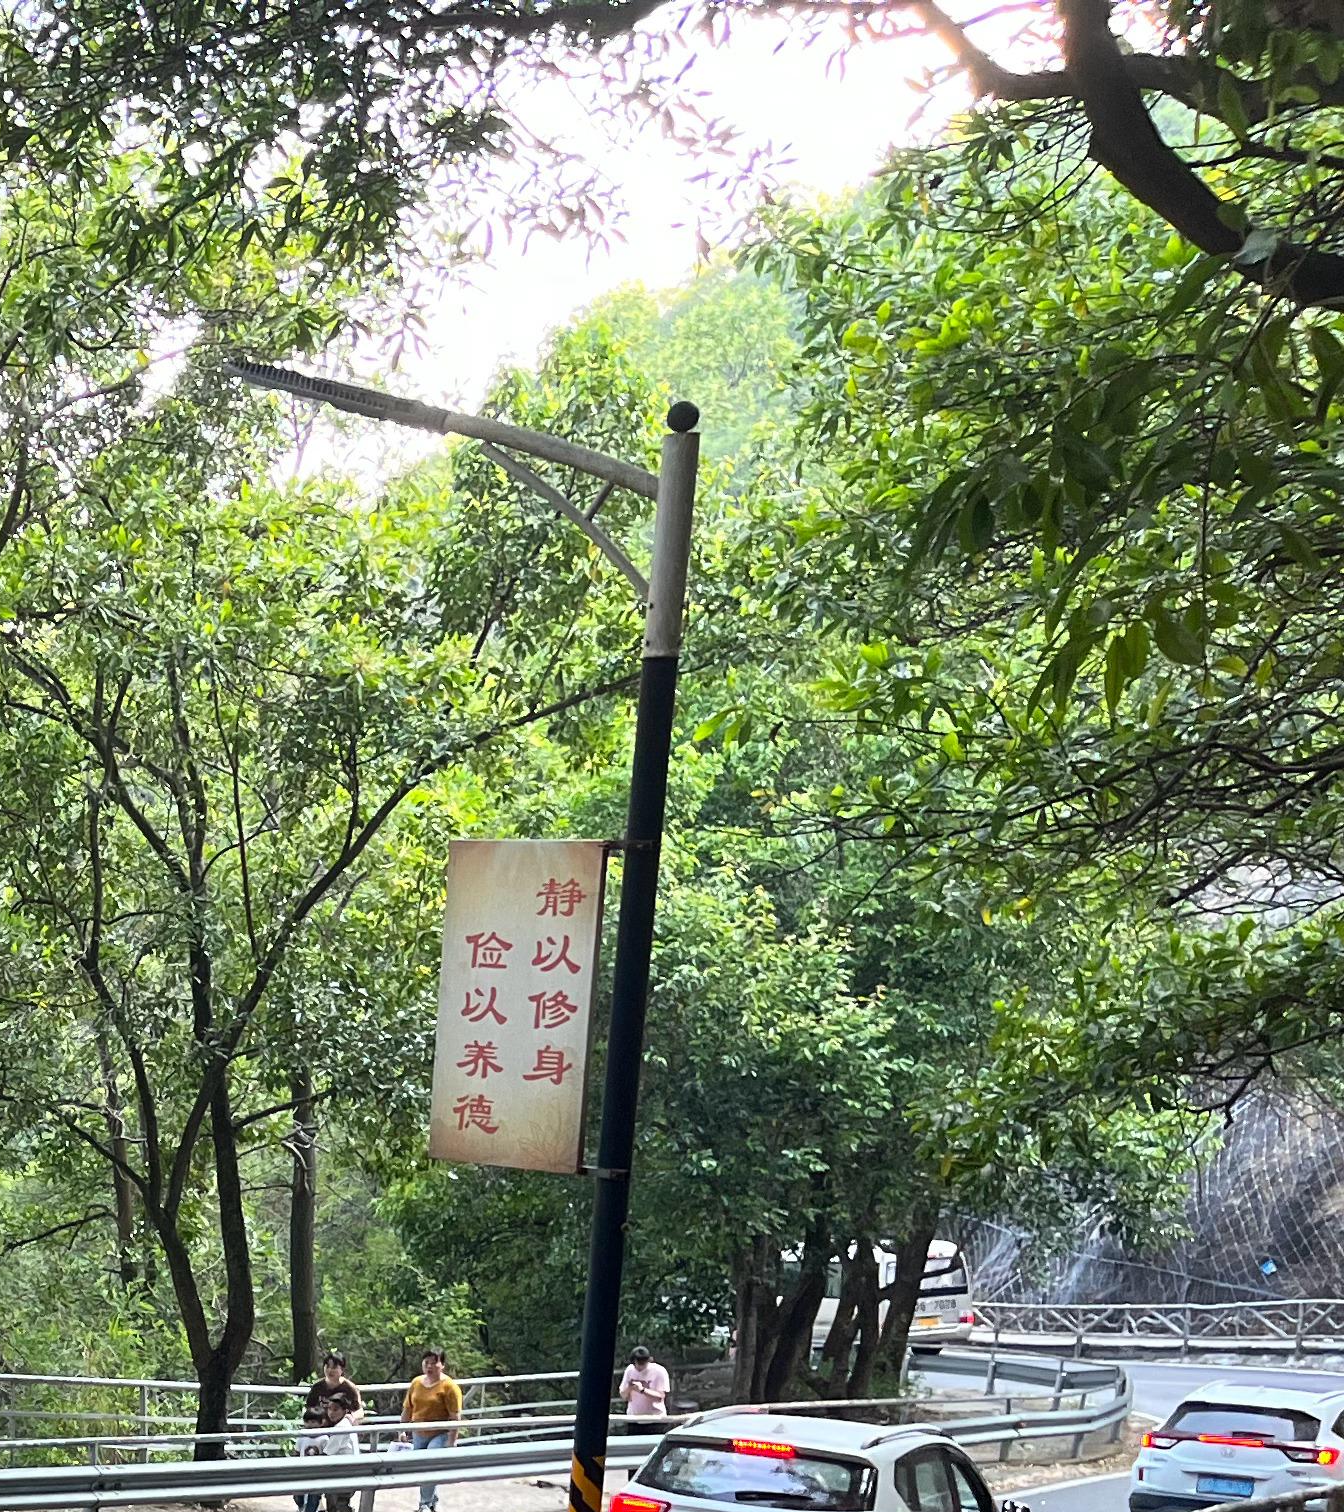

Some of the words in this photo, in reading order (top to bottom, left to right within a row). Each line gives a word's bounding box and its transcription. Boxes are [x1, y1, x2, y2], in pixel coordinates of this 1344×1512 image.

[451, 931, 514, 1135] 俭以养德
[521, 877, 587, 1086] 静以修身
